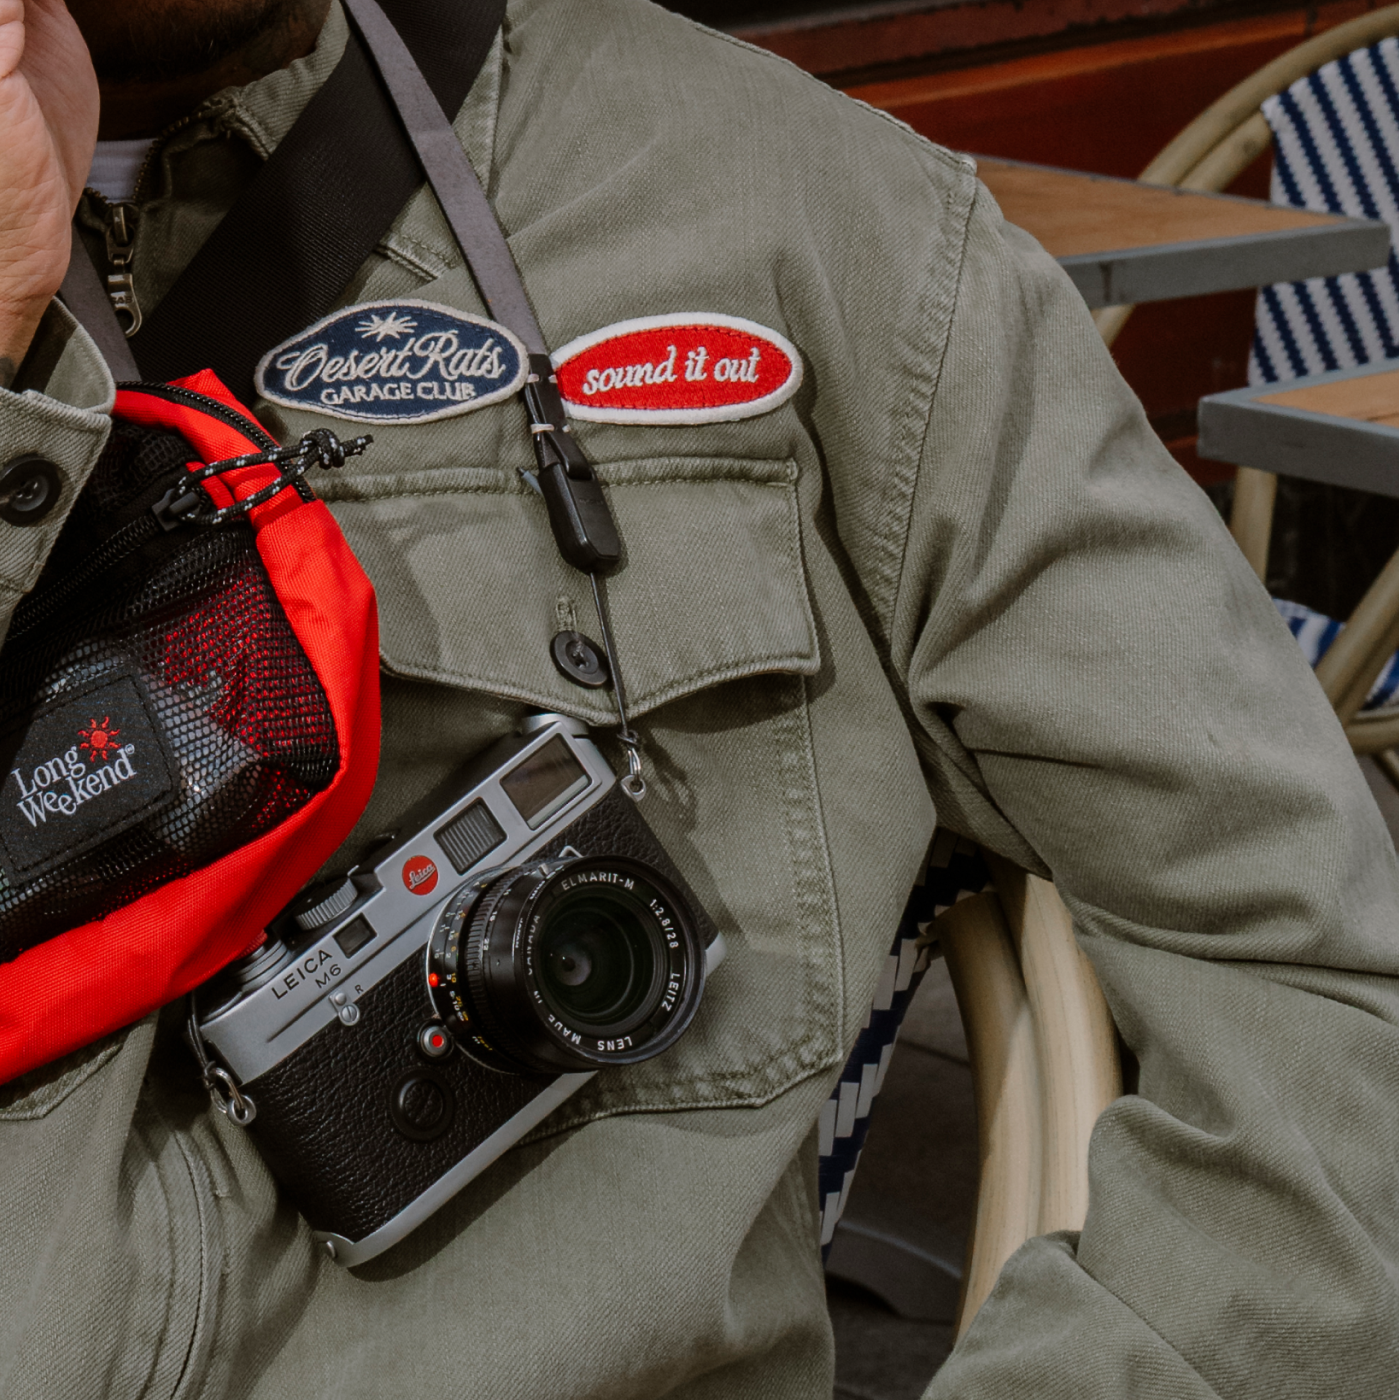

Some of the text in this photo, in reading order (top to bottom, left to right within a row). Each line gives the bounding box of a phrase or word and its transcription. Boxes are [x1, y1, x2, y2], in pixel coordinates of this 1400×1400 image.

[277, 330, 506, 391] Desert Rats
[582, 344, 761, 395] sound it out
[320, 379, 477, 405] GARAGE CLUB
[11, 746, 86, 799] Long
[408, 863, 436, 890] Leica
[561, 871, 635, 891] ELMARIT-M
[649, 899, 679, 949] 1:2.8/28
[271, 950, 333, 1000] LEICA
[314, 963, 342, 989] M6
[354, 984, 364, 995] R
[661, 972, 681, 1012] LEITZ
[597, 1035, 633, 1051] LENS
